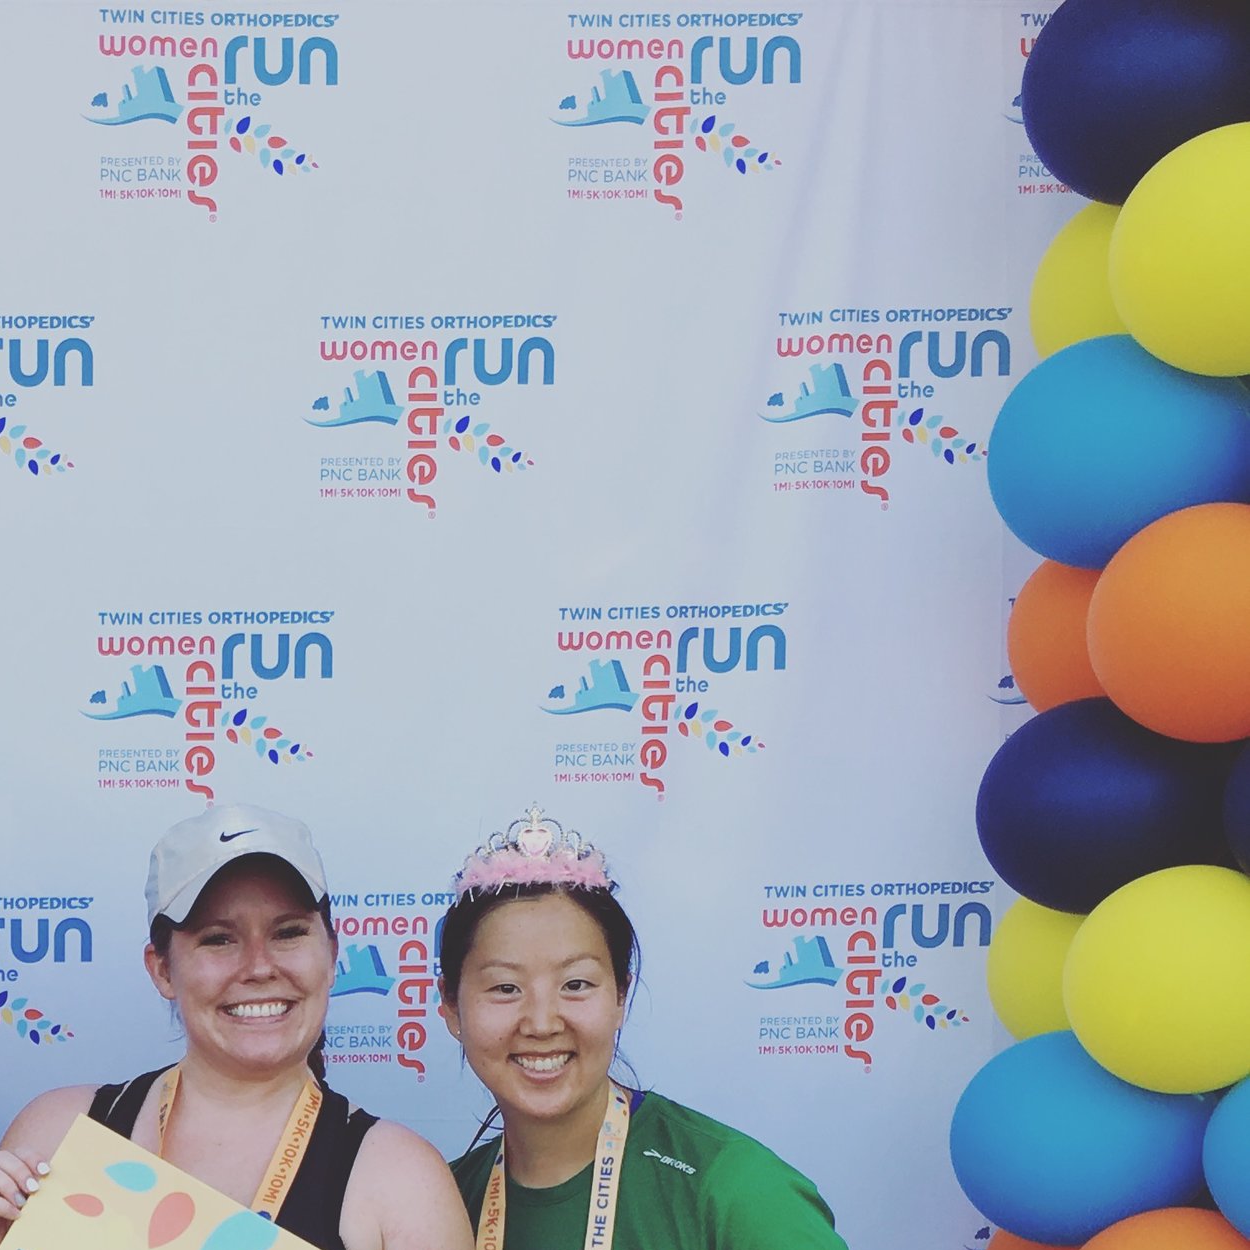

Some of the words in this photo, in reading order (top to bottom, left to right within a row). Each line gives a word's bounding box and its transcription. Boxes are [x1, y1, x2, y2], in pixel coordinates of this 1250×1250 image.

[98, 8, 144, 22] TWIN
[151, 11, 204, 25] CITIES
[96, 35, 218, 58] women
[224, 35, 338, 86] run
[566, 38, 684, 60] women
[690, 35, 801, 85] run
[224, 88, 261, 106] the
[690, 87, 726, 105] the
[186, 63, 226, 213] cities
[653, 64, 692, 211] cities
[100, 168, 131, 183] PNC
[137, 168, 181, 183] BANK
[101, 156, 164, 168] PRESENTED
[167, 157, 181, 168] BY
[318, 339, 438, 361] women
[444, 336, 556, 385] run
[775, 333, 893, 356] women
[898, 328, 1009, 378] run
[444, 388, 480, 406] the
[898, 381, 934, 399] the
[406, 366, 446, 510] cities
[860, 358, 900, 500] cities
[96, 636, 215, 657] women
[221, 632, 333, 679] run
[557, 629, 671, 651] women
[676, 624, 784, 672] run
[221, 682, 258, 699] the
[674, 676, 709, 693] the
[184, 659, 223, 799] cities
[639, 653, 678, 792] cities
[763, 885, 806, 898] TWIN
[813, 884, 864, 897] CITIES
[760, 906, 877, 927] women
[882, 901, 992, 948] run
[882, 951, 917, 968] the
[844, 930, 883, 1064] cities
[760, 1027, 790, 1040] PNC
[796, 1026, 839, 1040] BANK
[761, 1016, 821, 1026] PRESENTED
[826, 1016, 840, 1025] BY
[597, 1156, 615, 1209] CITIES
[592, 1215, 607, 1247] THE
